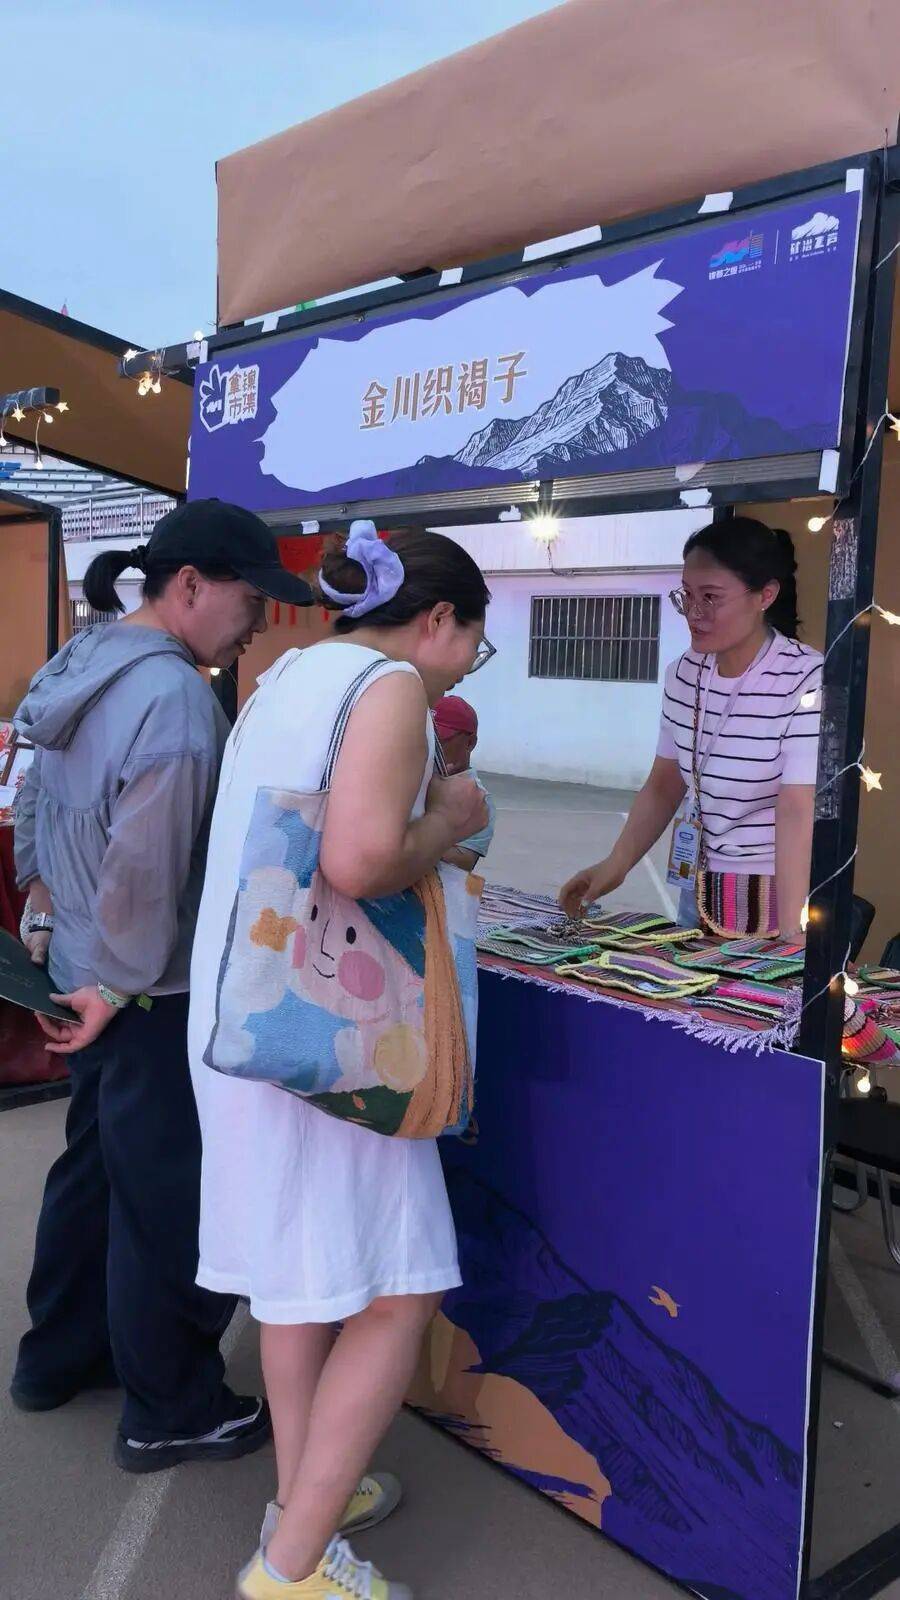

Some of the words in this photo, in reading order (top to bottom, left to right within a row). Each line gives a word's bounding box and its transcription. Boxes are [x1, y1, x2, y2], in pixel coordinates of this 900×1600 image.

[228, 393, 257, 419] 市集
[358, 350, 528, 431] 金川织褐子
